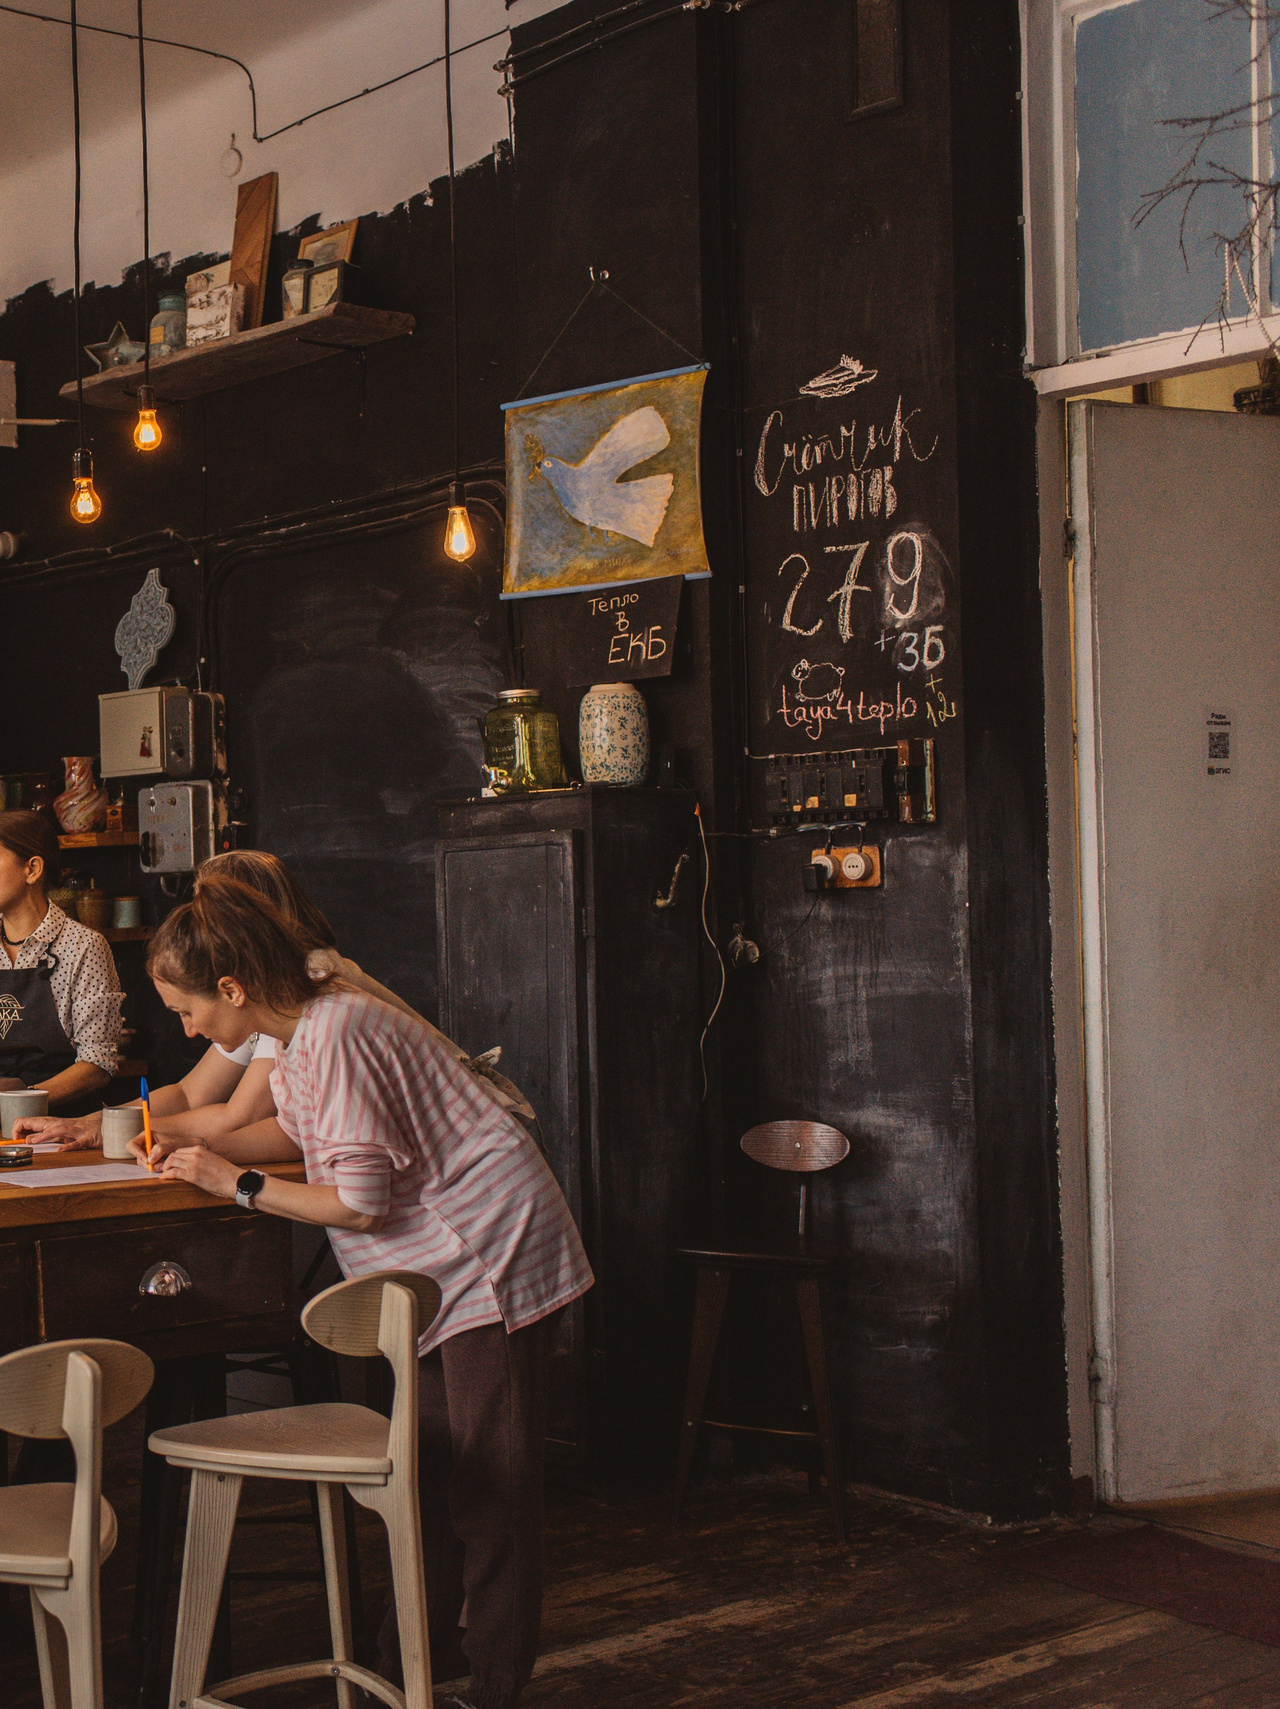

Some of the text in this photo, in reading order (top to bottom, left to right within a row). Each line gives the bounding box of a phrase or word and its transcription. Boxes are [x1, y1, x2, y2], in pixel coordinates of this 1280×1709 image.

[587, 593, 639, 616] Тепло
[778, 531, 924, 643] 279
[608, 625, 667, 664] ЕКБ
